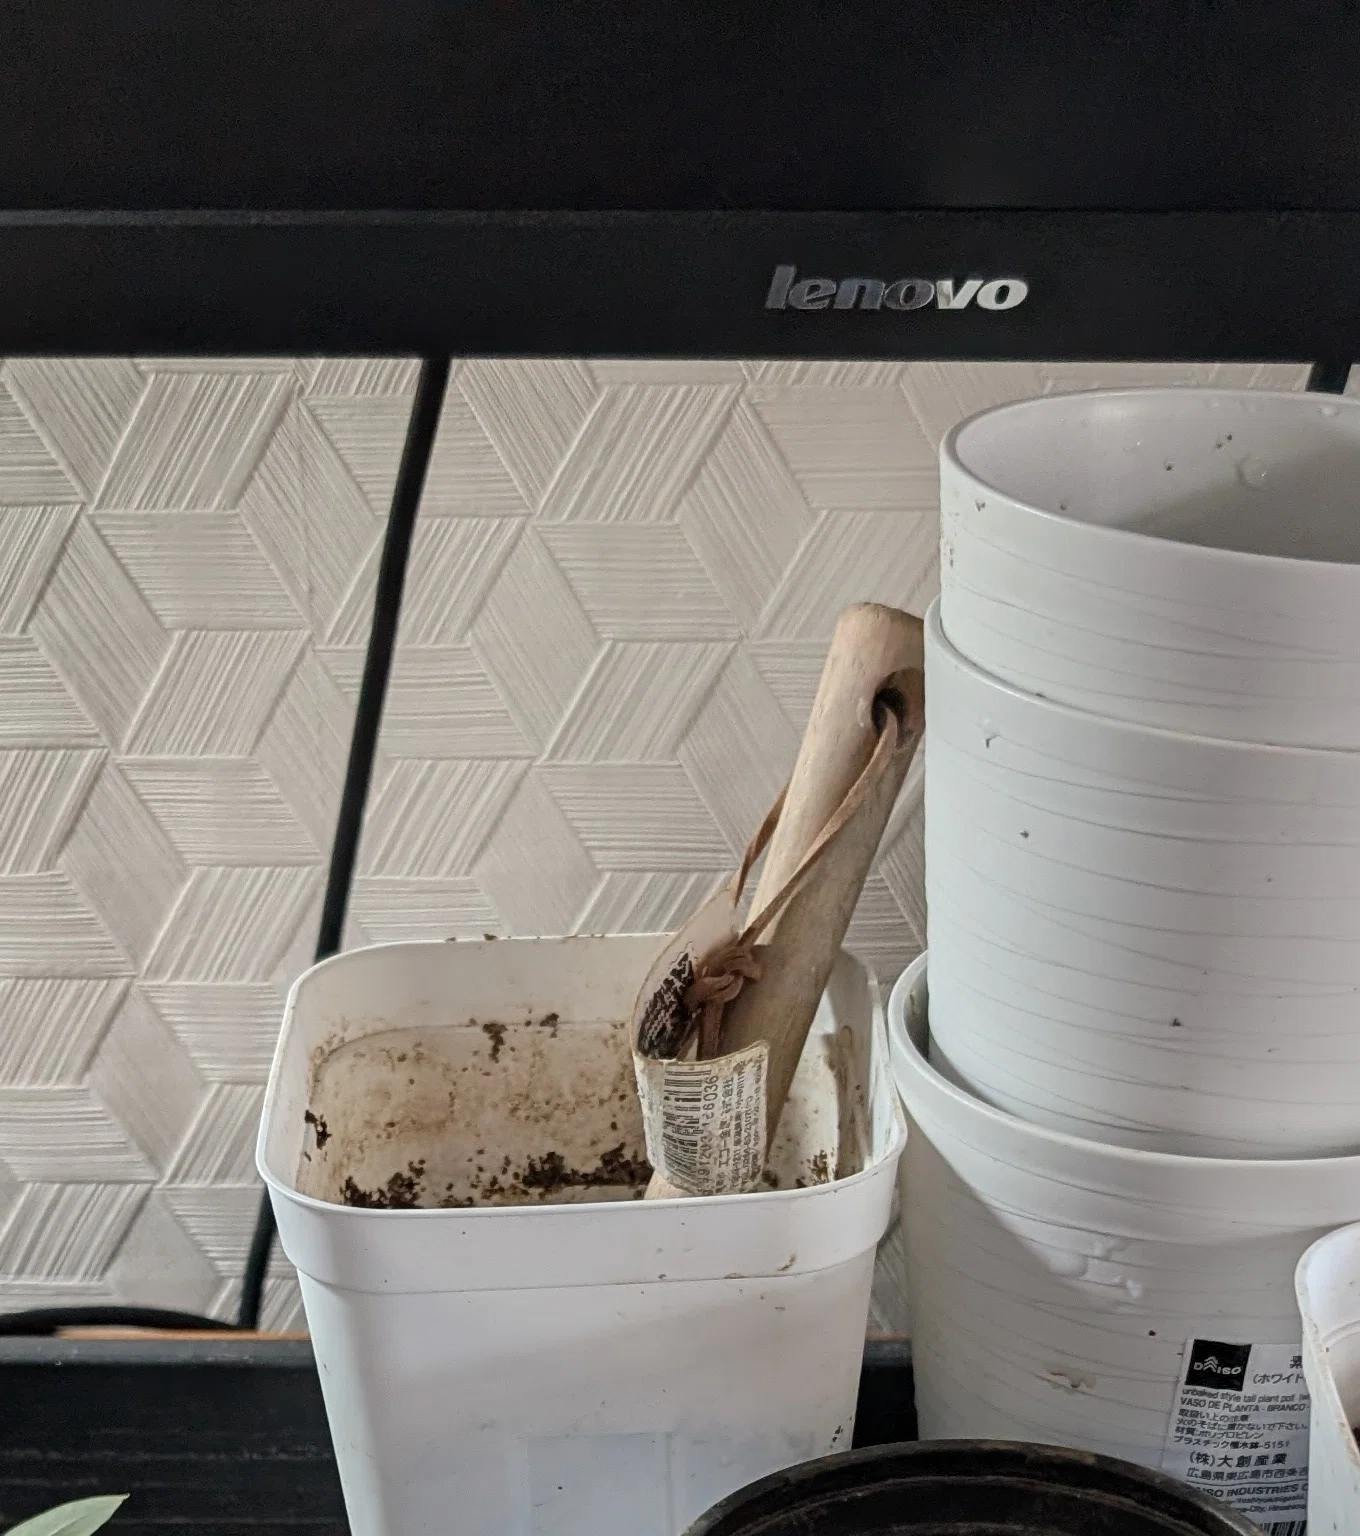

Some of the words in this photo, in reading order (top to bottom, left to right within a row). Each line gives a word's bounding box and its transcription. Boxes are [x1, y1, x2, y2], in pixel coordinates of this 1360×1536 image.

[764, 264, 1028, 310] lenovo
[1193, 1356, 1242, 1375] DAISO
[1180, 1396, 1206, 1408] VASO
[1208, 1400, 1221, 1409] DE
[1222, 1402, 1260, 1412] PLANTA
[1226, 1483, 1299, 1498] INDUSTRIES
